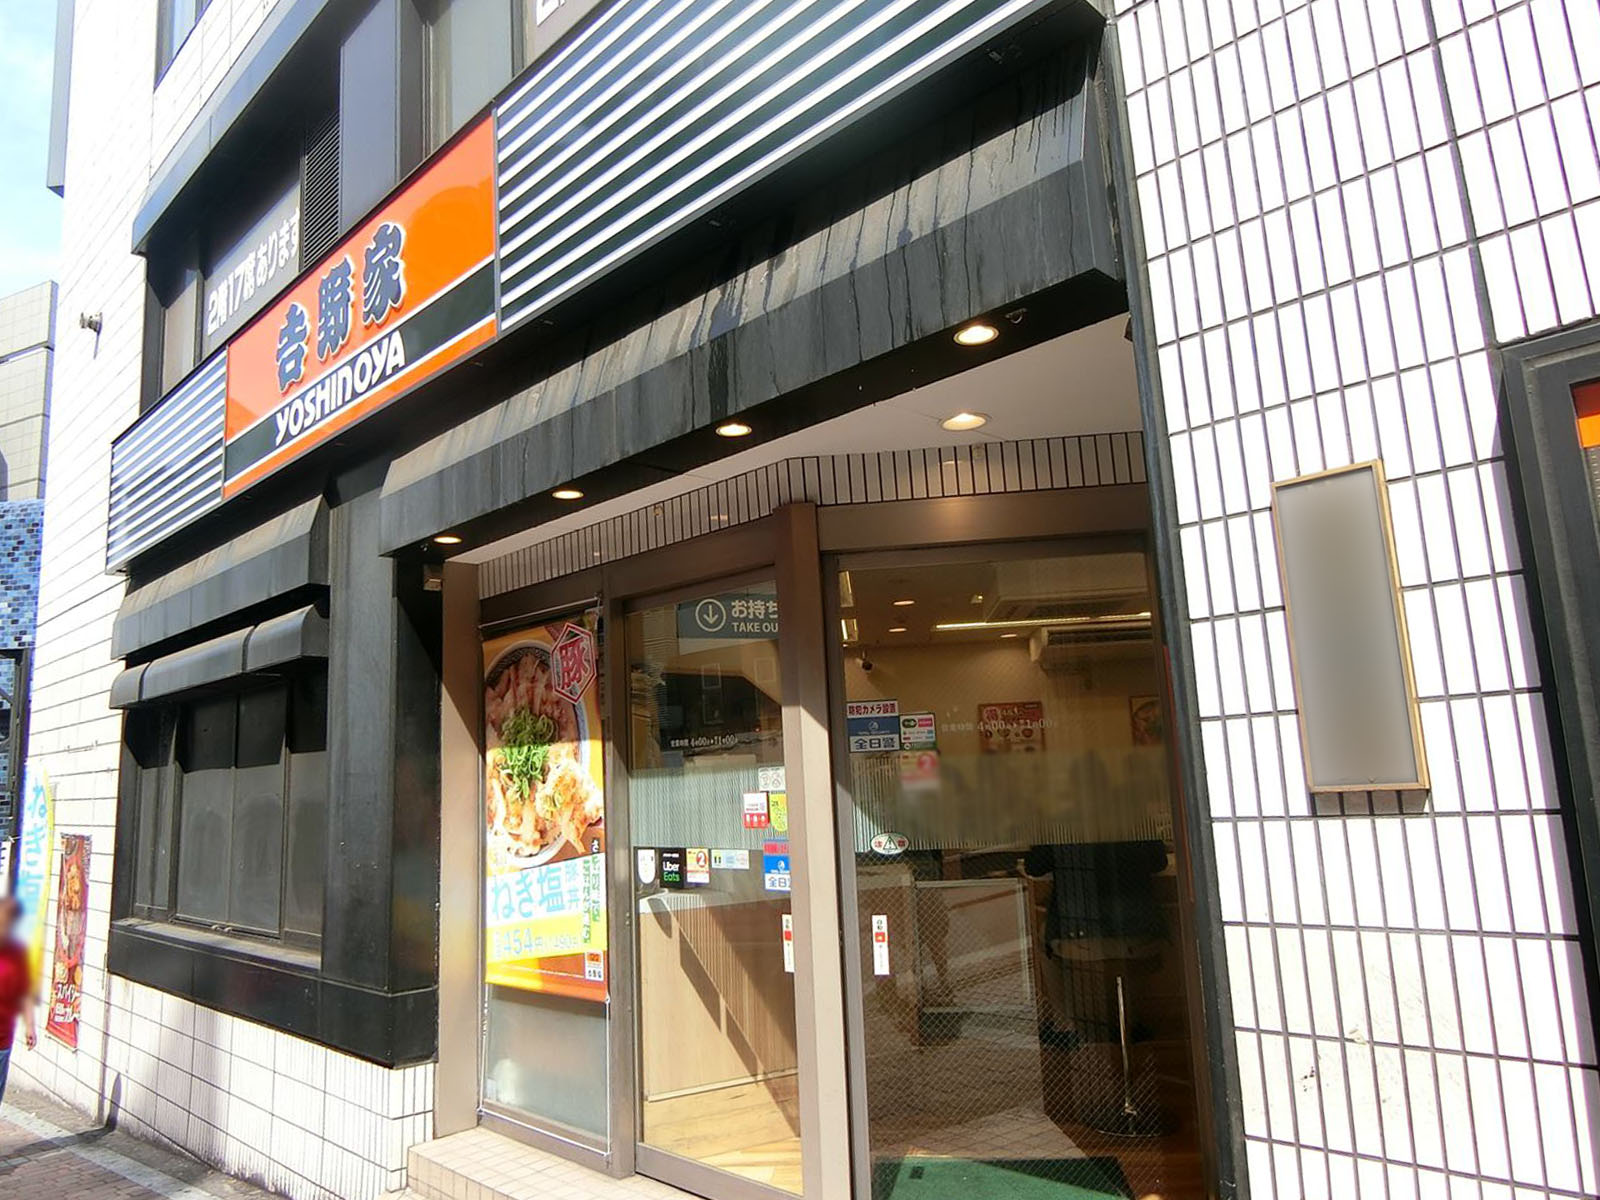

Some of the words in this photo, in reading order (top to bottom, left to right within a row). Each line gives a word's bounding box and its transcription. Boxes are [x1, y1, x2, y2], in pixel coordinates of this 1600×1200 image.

[276, 222, 405, 394] 吉野家
[731, 600, 778, 618] お持ち
[732, 623, 760, 632] TAKE
[848, 703, 896, 715] 防犯カメラ設置
[663, 861, 680, 872] Uber
[663, 872, 680, 882] Eats
[768, 876, 791, 888] 全日
[491, 865, 566, 920] ねぎ塩
